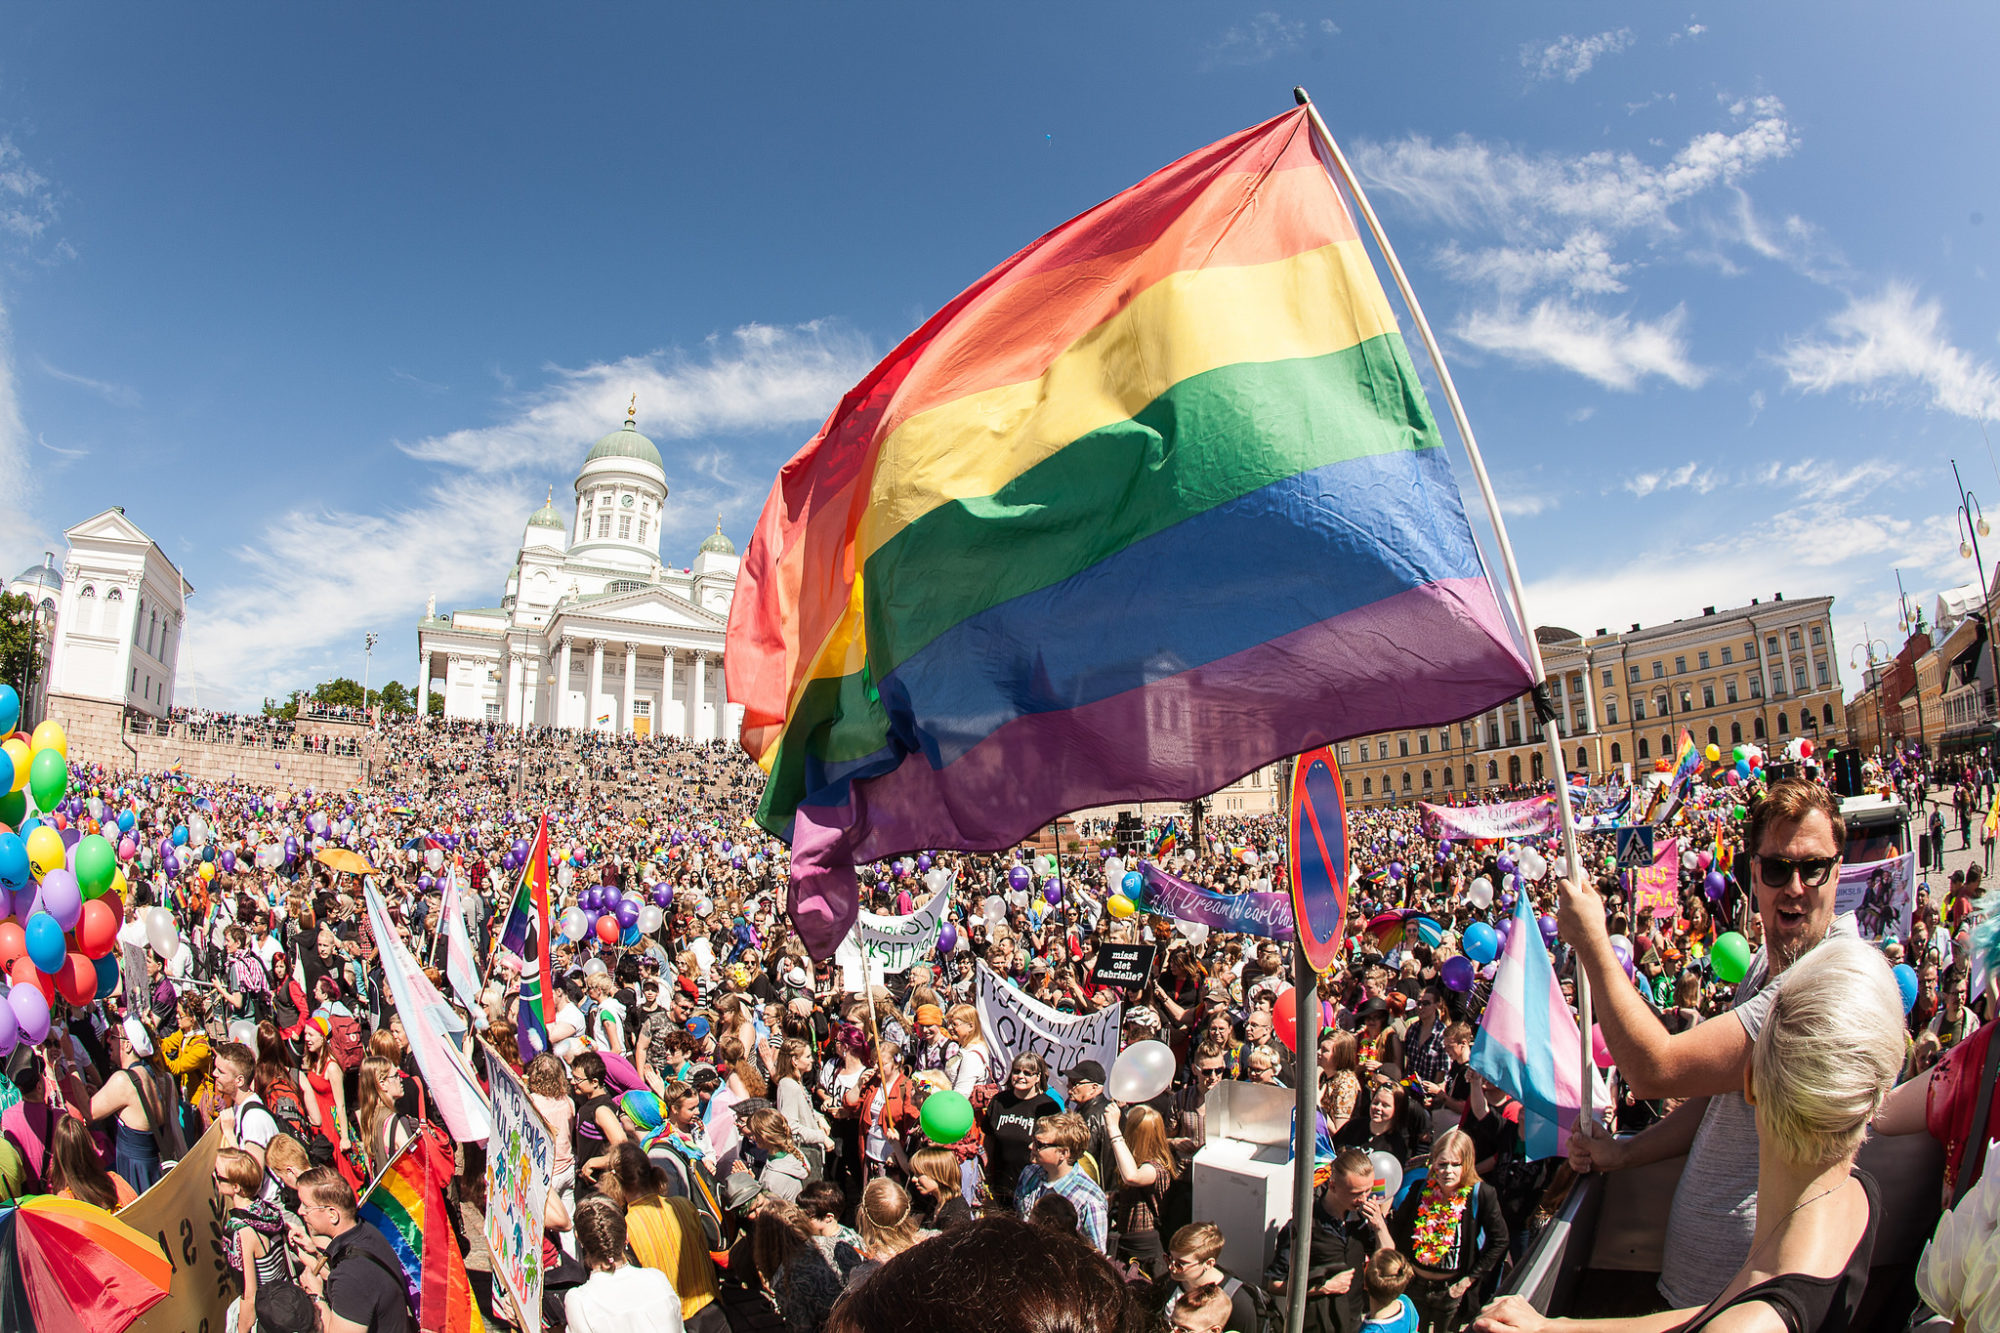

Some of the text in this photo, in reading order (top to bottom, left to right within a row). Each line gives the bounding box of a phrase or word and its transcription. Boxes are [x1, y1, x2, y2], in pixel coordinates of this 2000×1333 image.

[1179, 891, 1294, 929] DreamWearClu
[1113, 961, 1132, 970] olet
[1097, 969, 1144, 981] Gabrielle?
